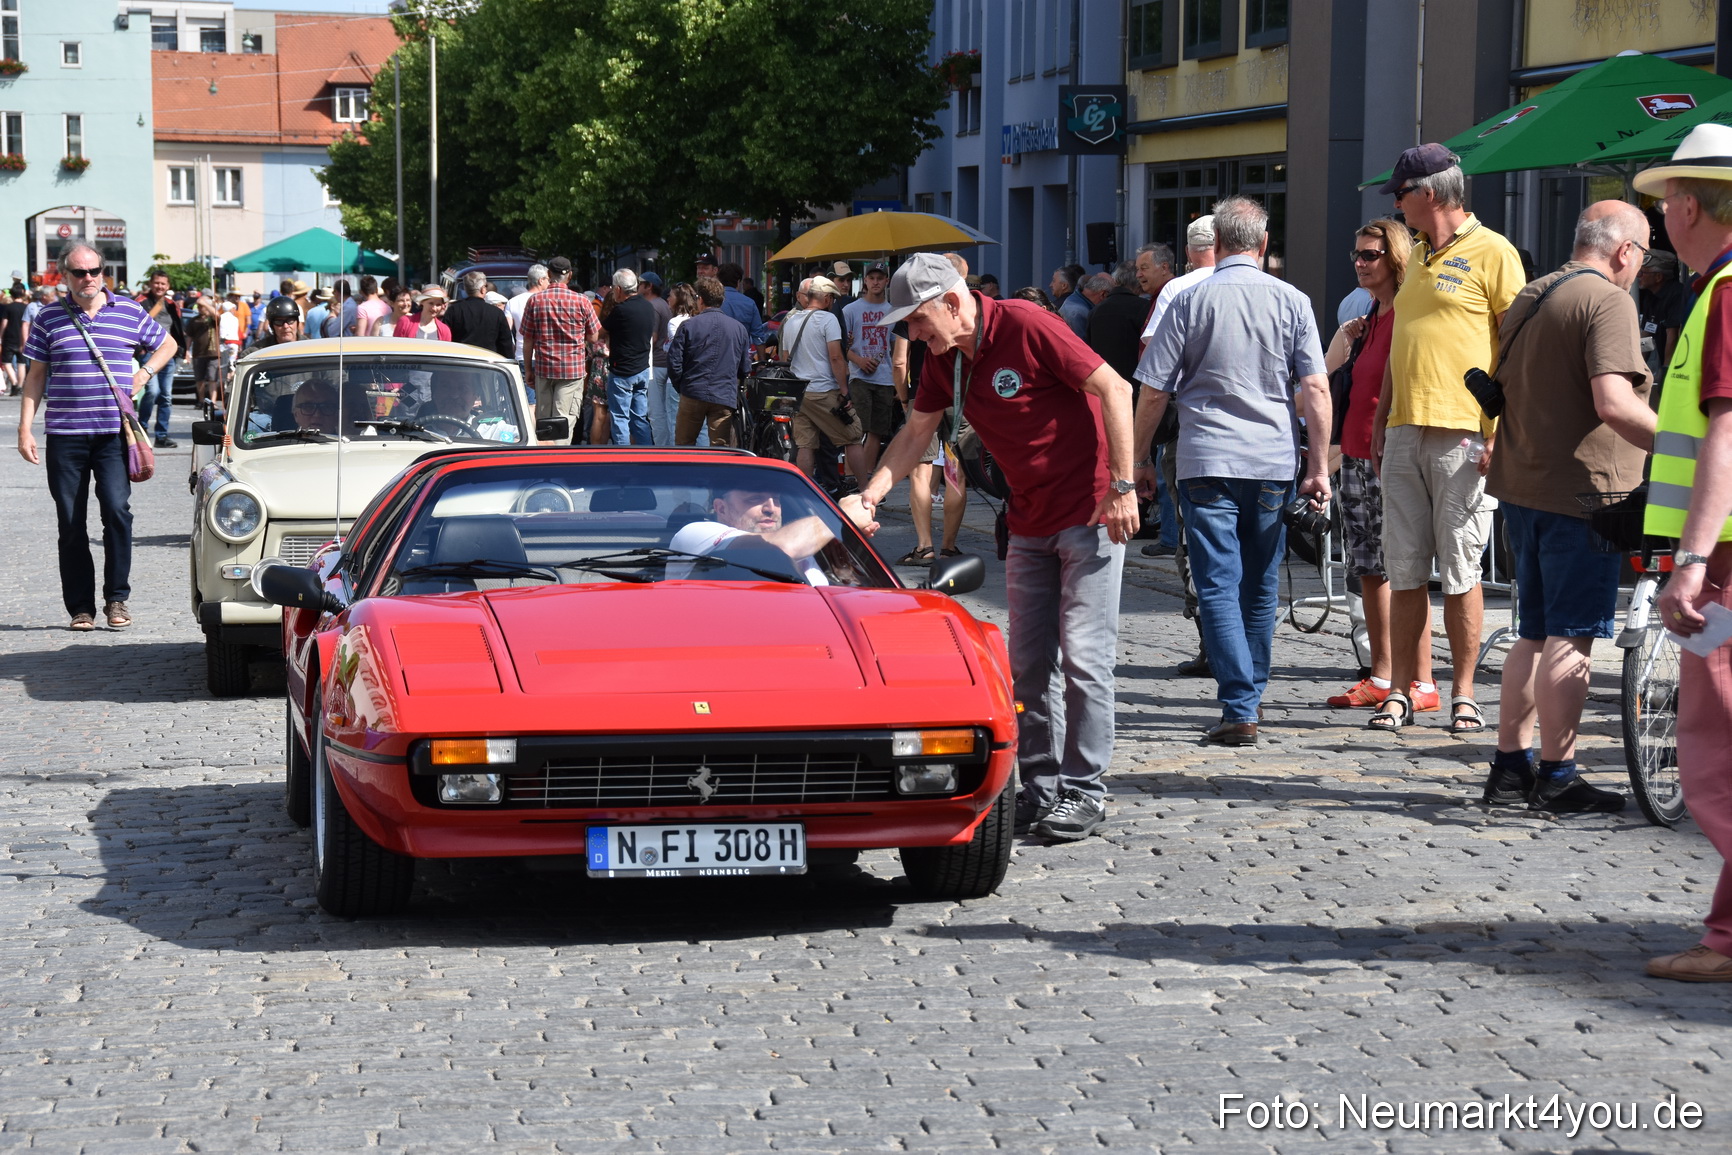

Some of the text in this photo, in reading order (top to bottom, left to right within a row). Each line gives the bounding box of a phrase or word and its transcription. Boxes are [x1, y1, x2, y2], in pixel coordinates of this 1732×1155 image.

[1083, 104, 1106, 132] G2
[618, 831, 637, 864] N
[662, 829, 699, 863] FI
[594, 853, 603, 864] D
[646, 868, 750, 877] MERTEL NÜRNBERG
